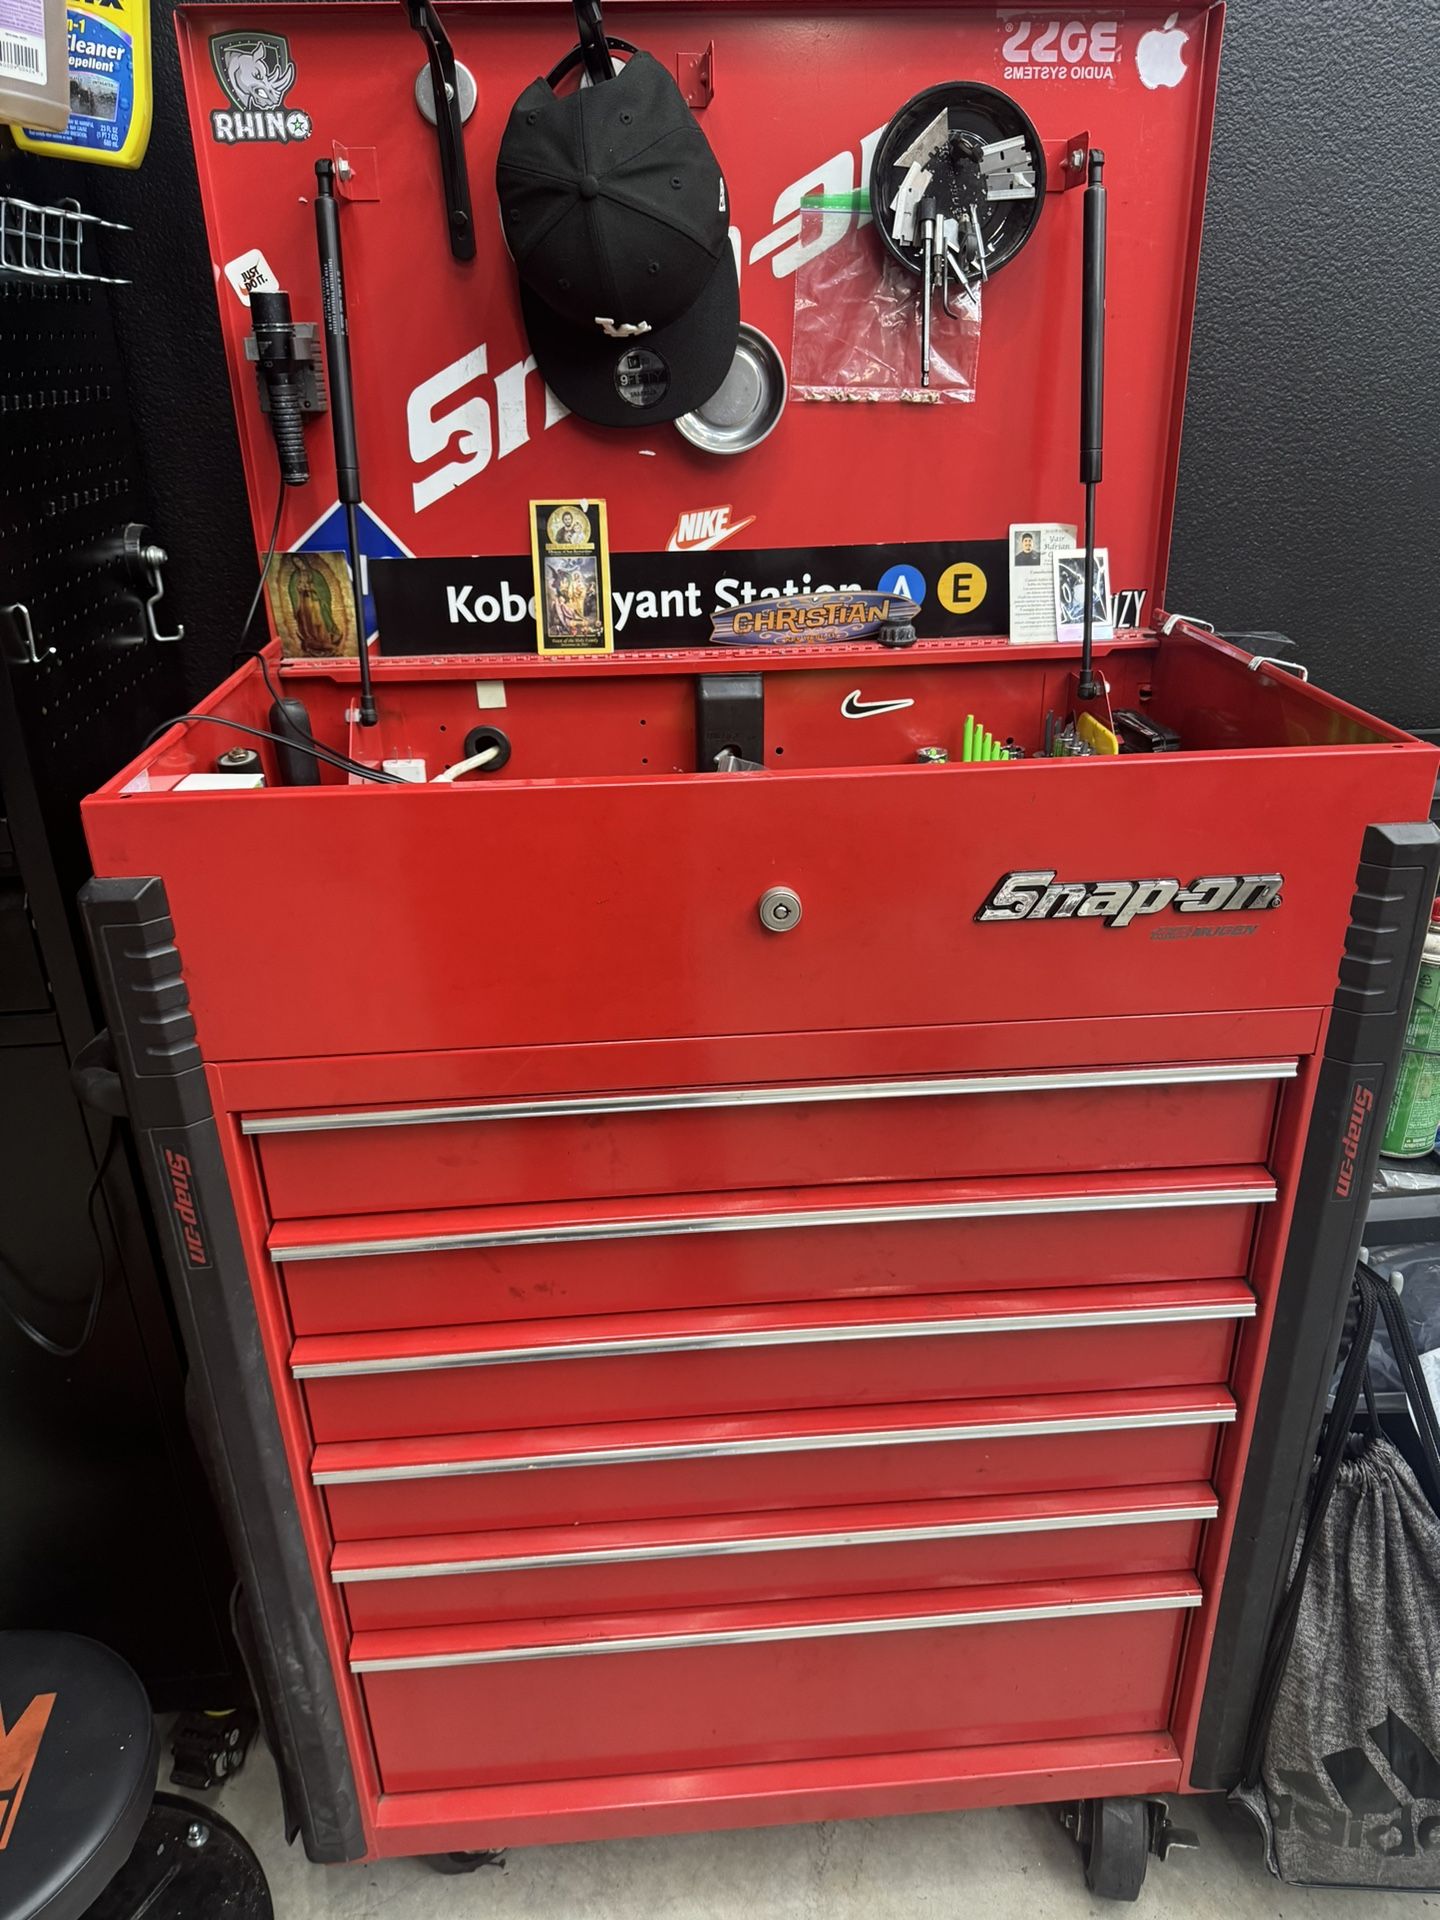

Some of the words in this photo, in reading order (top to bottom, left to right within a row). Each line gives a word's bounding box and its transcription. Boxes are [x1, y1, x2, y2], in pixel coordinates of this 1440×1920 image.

[68, 56, 114, 73] epellent
[213, 111, 310, 141] RHINO
[240, 265, 260, 282] JUST
[244, 279, 258, 292] DO
[677, 507, 730, 543] NIKE
[612, 582, 703, 631] yant
[892, 576, 913, 600] A
[953, 573, 973, 603] E
[732, 599, 890, 635] CHRISTIAN
[973, 870, 1284, 928] Snap-on
[1335, 1084, 1374, 1198] Snap-on
[165, 1148, 207, 1265] Snap-on
